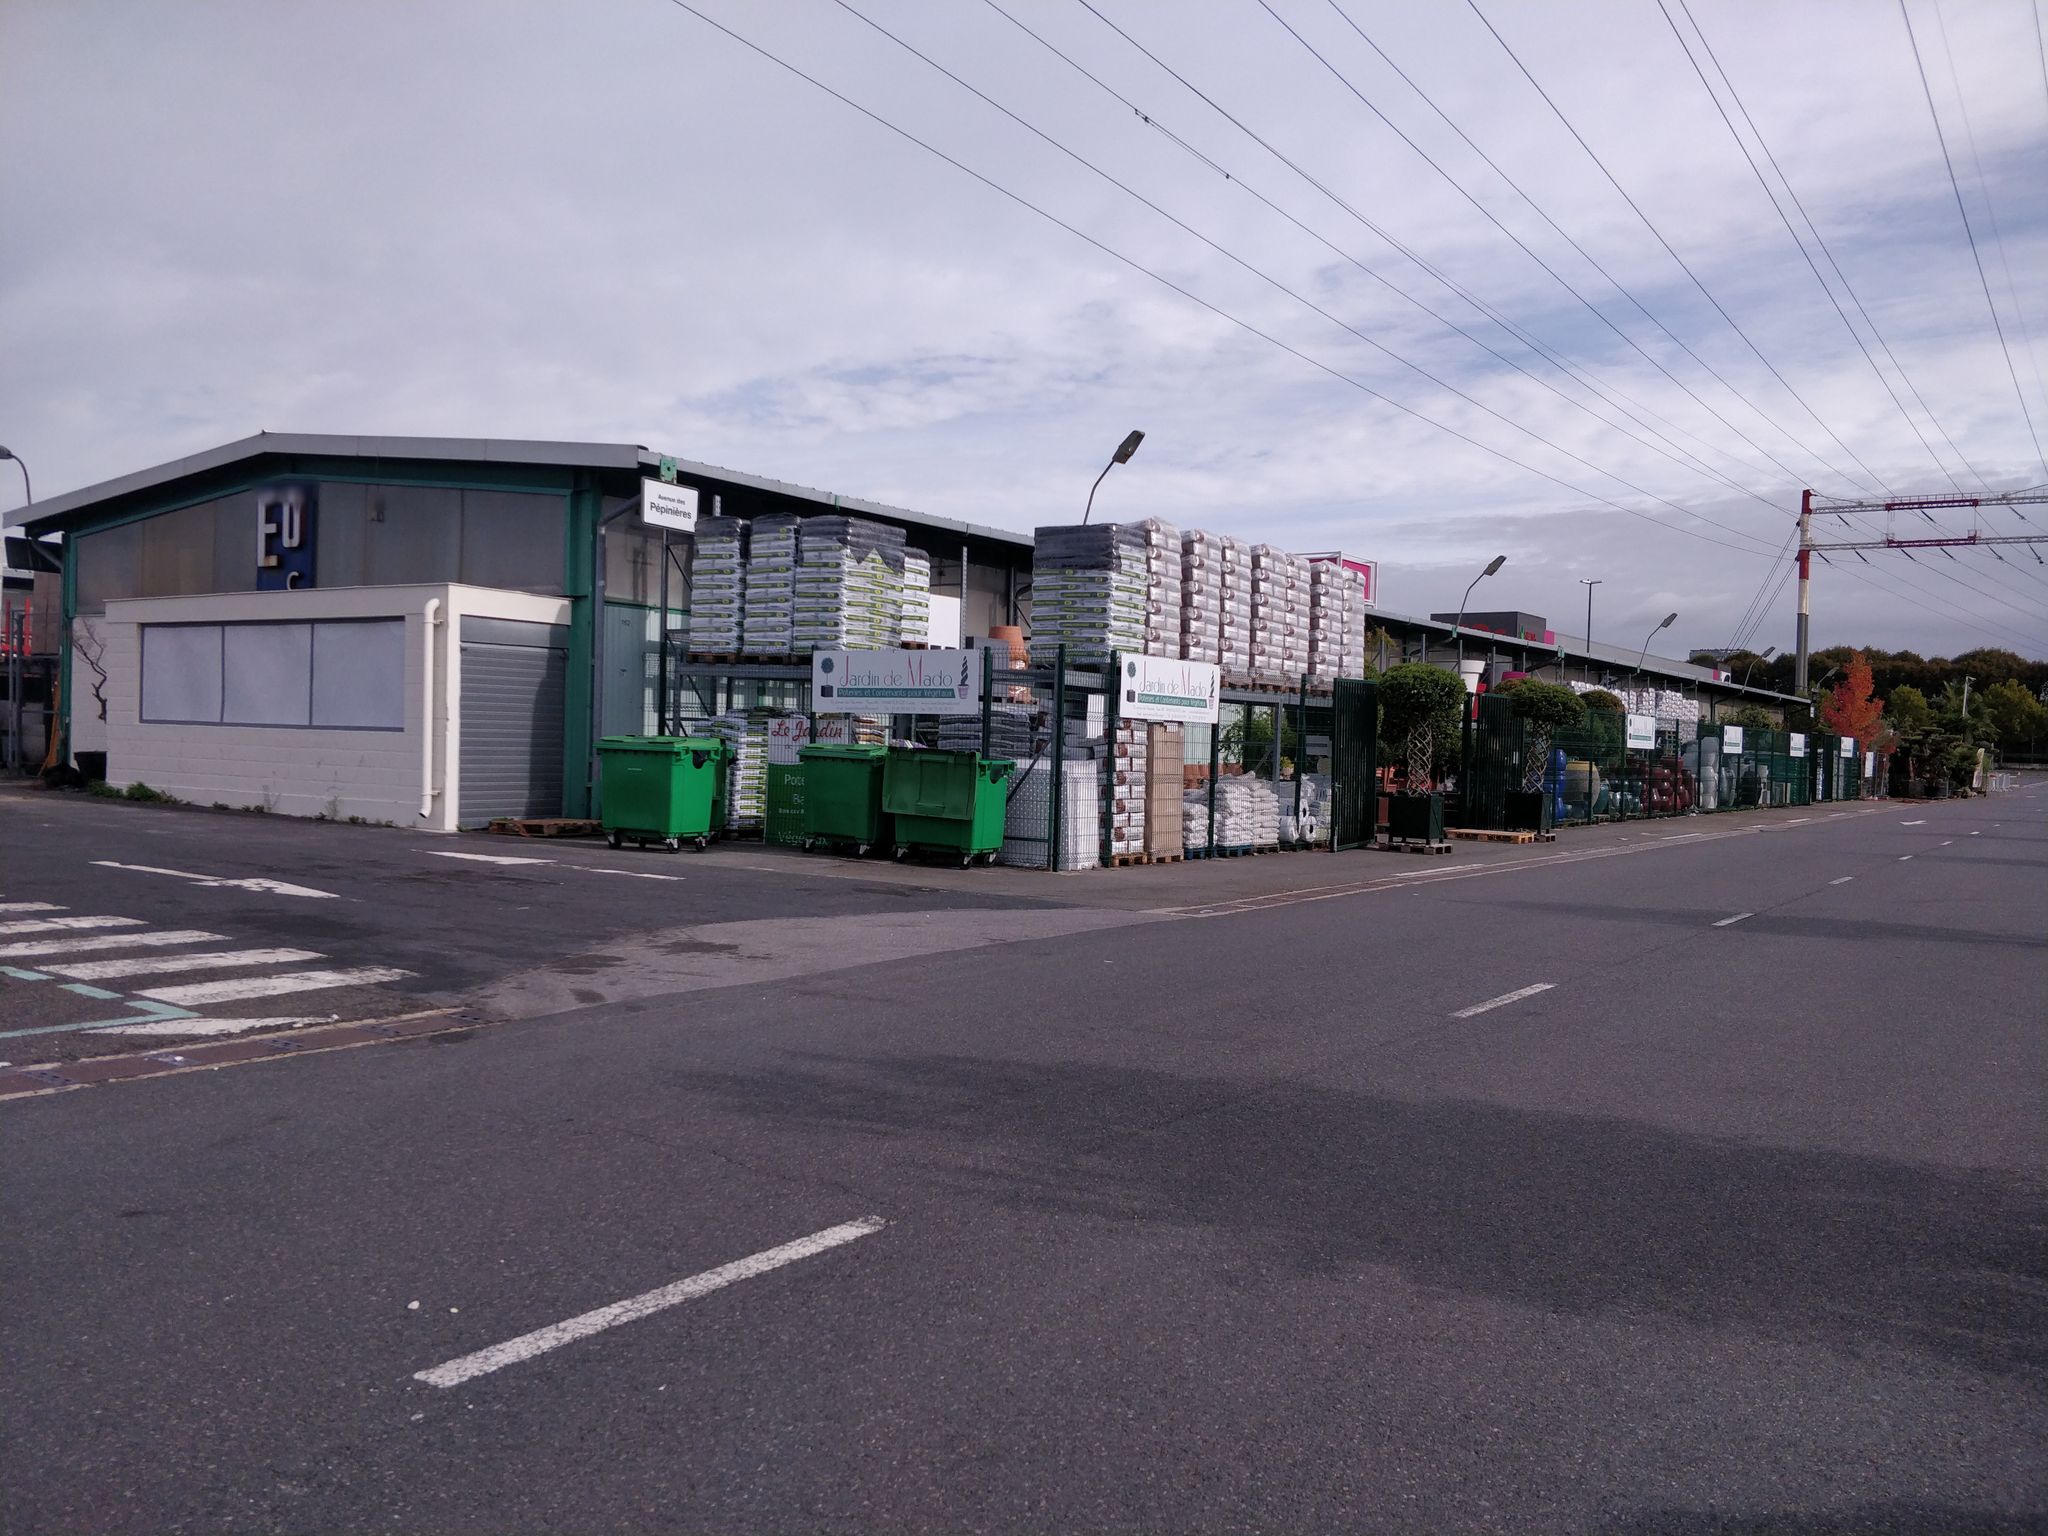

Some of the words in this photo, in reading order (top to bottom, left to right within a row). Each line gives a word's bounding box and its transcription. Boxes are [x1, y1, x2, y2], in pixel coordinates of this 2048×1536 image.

[650, 502, 692, 519] Pépinières
[658, 494, 676, 503] Avenue
[840, 655, 880, 687] Jardin
[883, 669, 903, 687] de
[907, 654, 953, 687] Mado
[1139, 660, 1165, 693] Jardin
[1167, 679, 1179, 694] de
[1181, 665, 1206, 697] Mado
